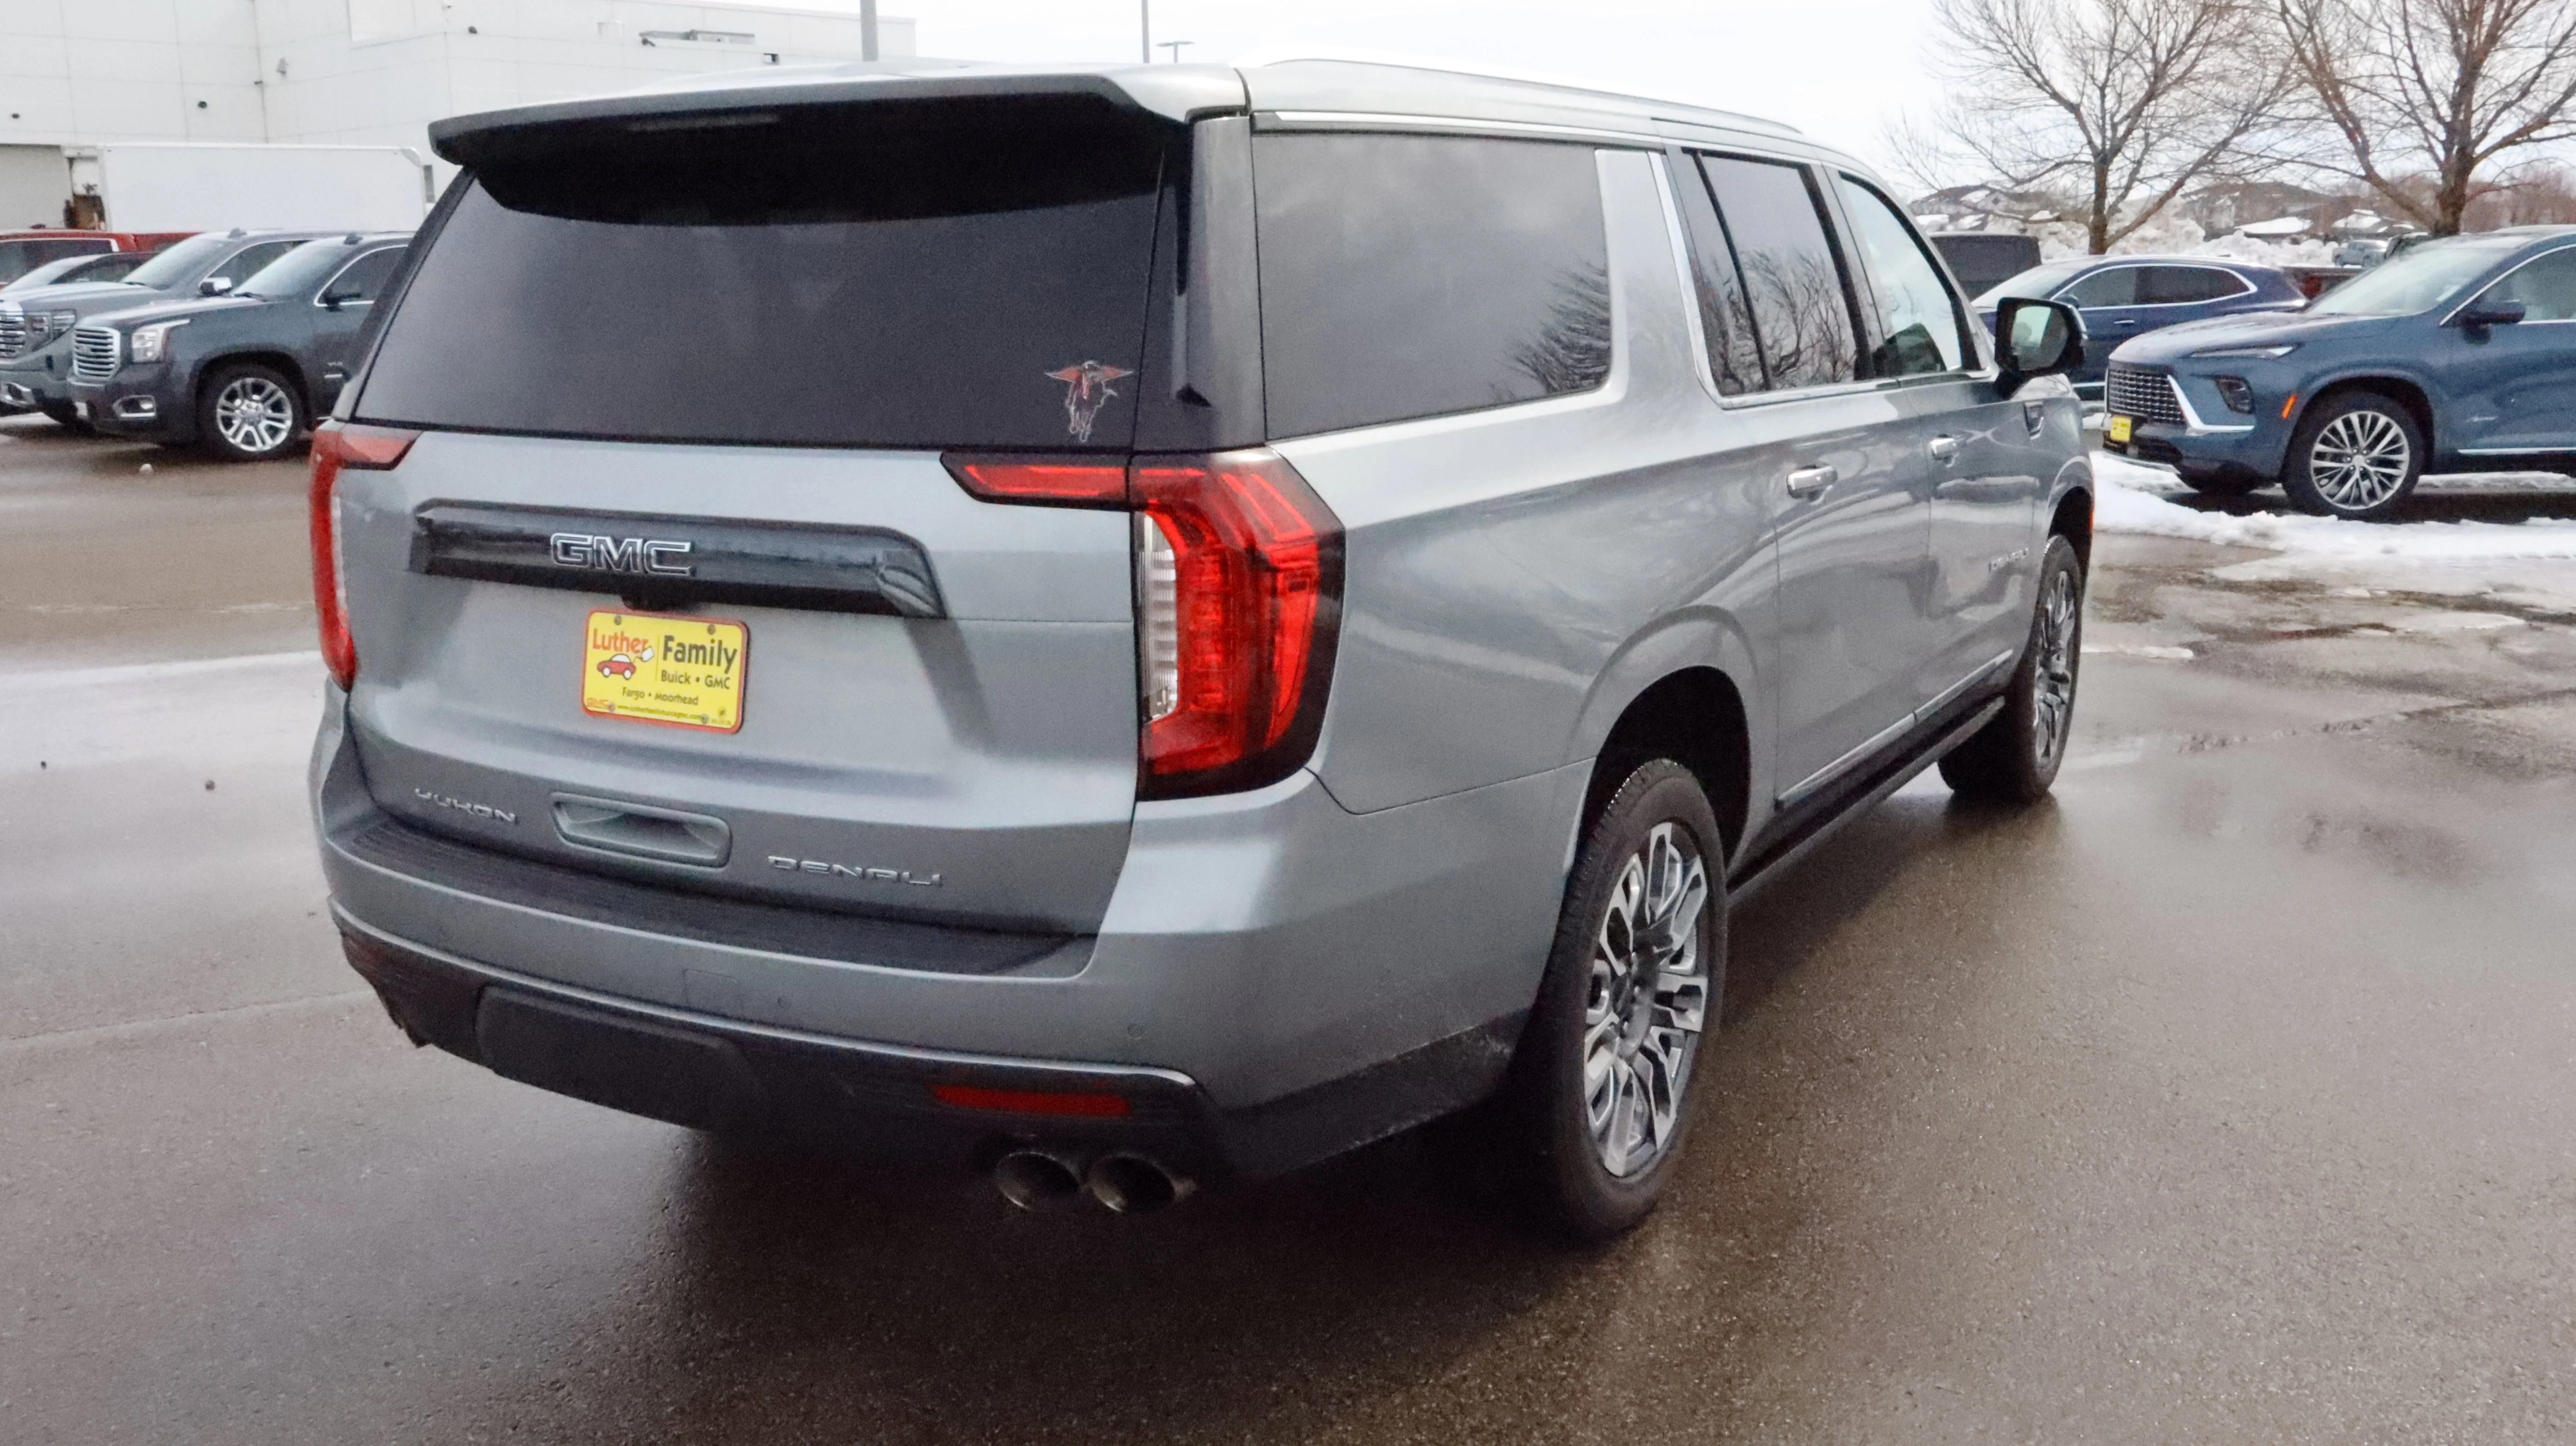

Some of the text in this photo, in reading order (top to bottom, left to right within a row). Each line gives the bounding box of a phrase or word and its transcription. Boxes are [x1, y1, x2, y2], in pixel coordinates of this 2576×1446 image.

[551, 533, 691, 576] GMC
[593, 628, 737, 674] Luther Family
[661, 670, 730, 690] Buick GMC
[622, 687, 699, 706] Fargo Moorhead
[415, 788, 515, 822] YUKON
[768, 856, 940, 885] DENALI
